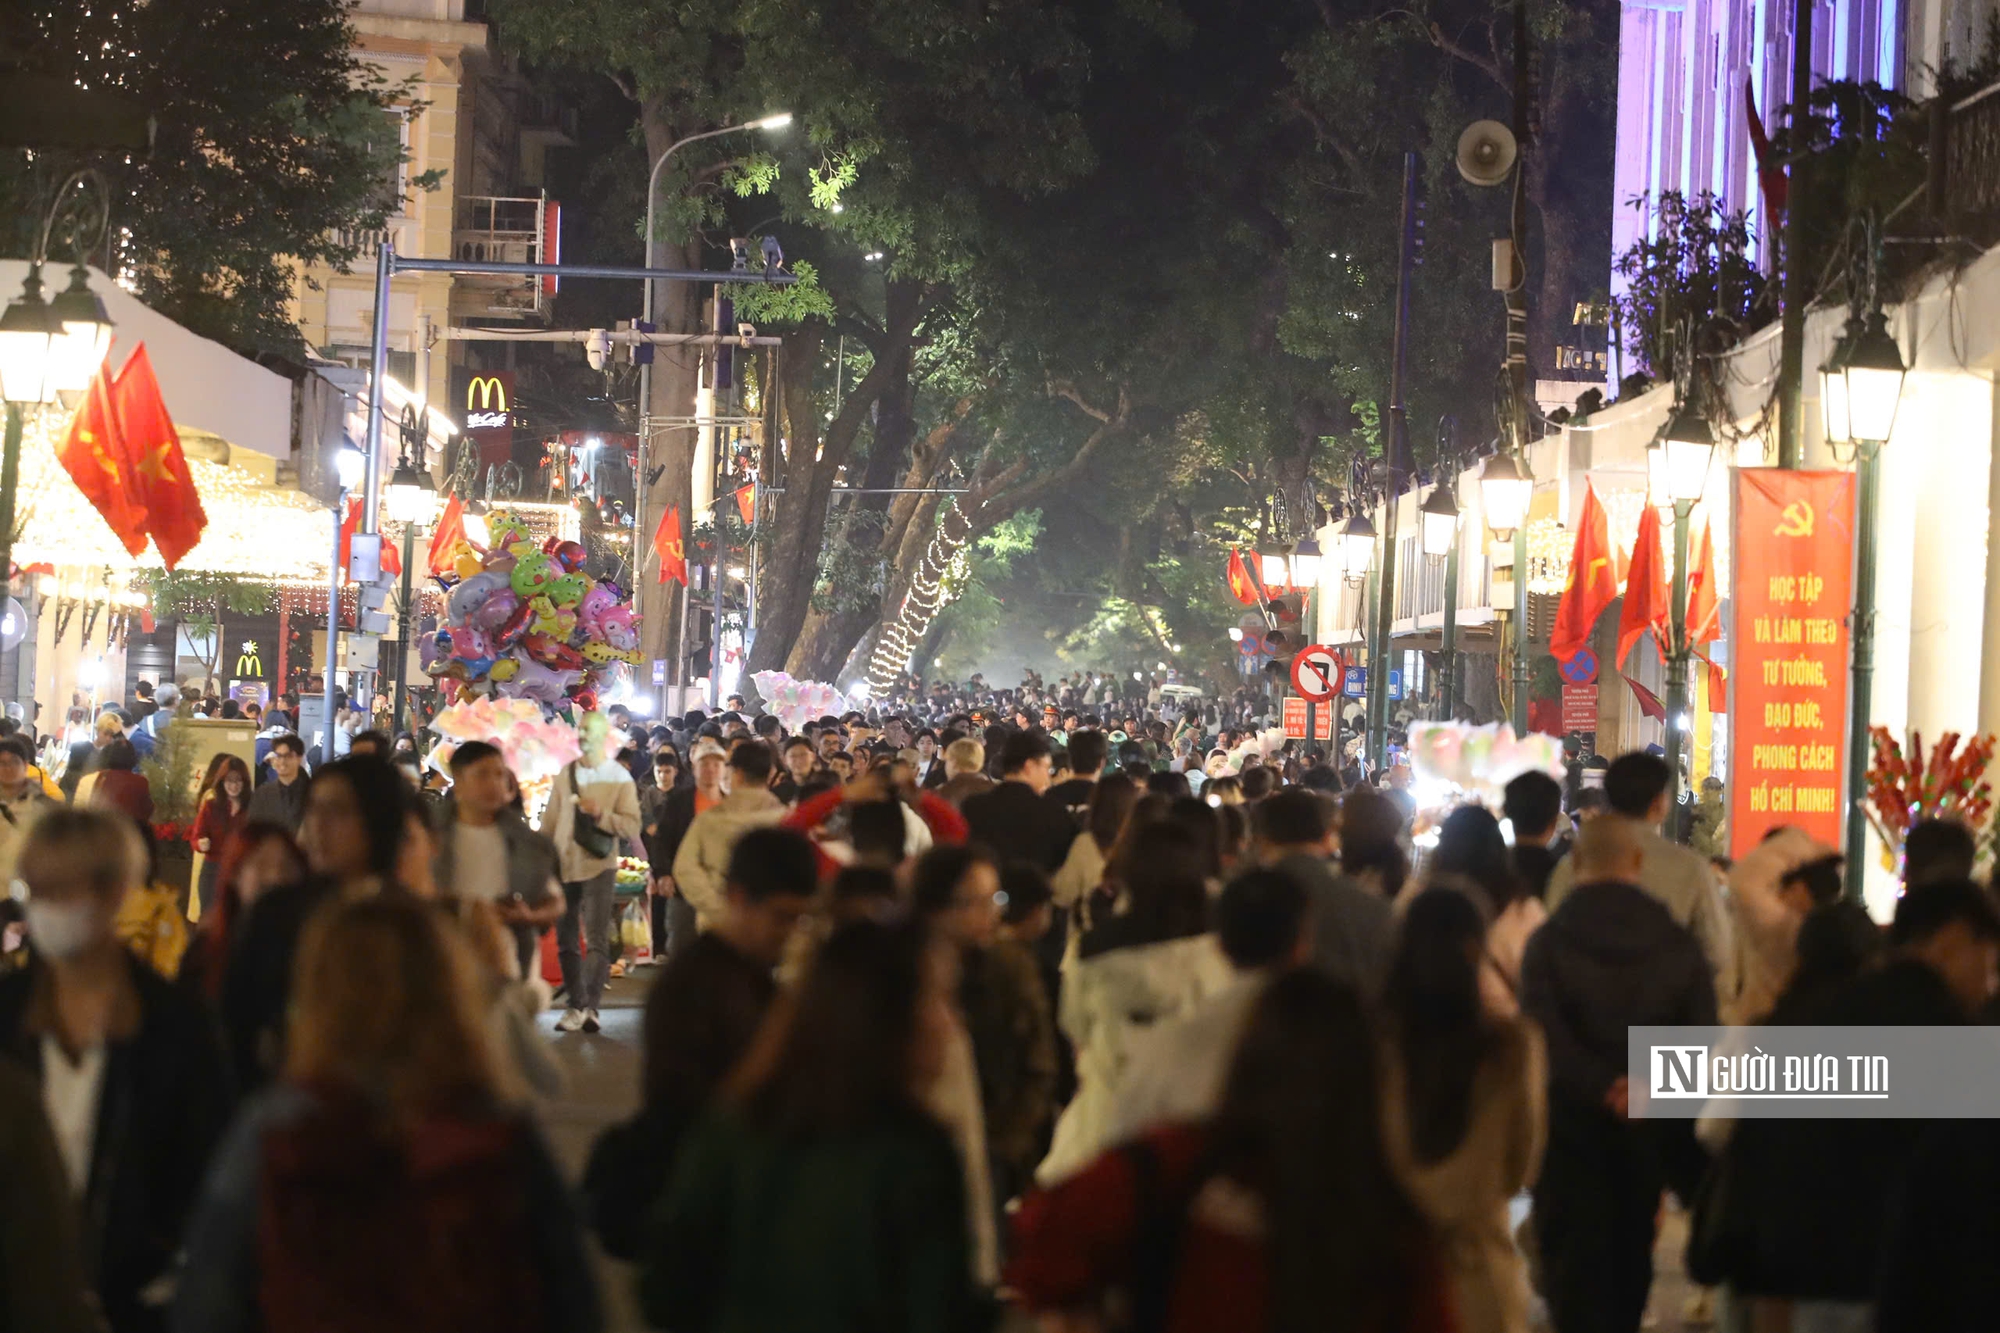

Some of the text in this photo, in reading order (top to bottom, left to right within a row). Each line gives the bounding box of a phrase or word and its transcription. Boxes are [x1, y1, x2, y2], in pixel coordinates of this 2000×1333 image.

[1769, 571, 1823, 606] HỌC TẬP
[1754, 613, 1837, 644] VÀ LÀM THEO
[1763, 653, 1828, 688] TƯ TƯỞNG,
[1764, 698, 1824, 734] ĐẠO ĐỨC,
[1753, 740, 1835, 770] PHONG CÁCH
[1750, 779, 1835, 812] HỒ CHÍ MINH!
